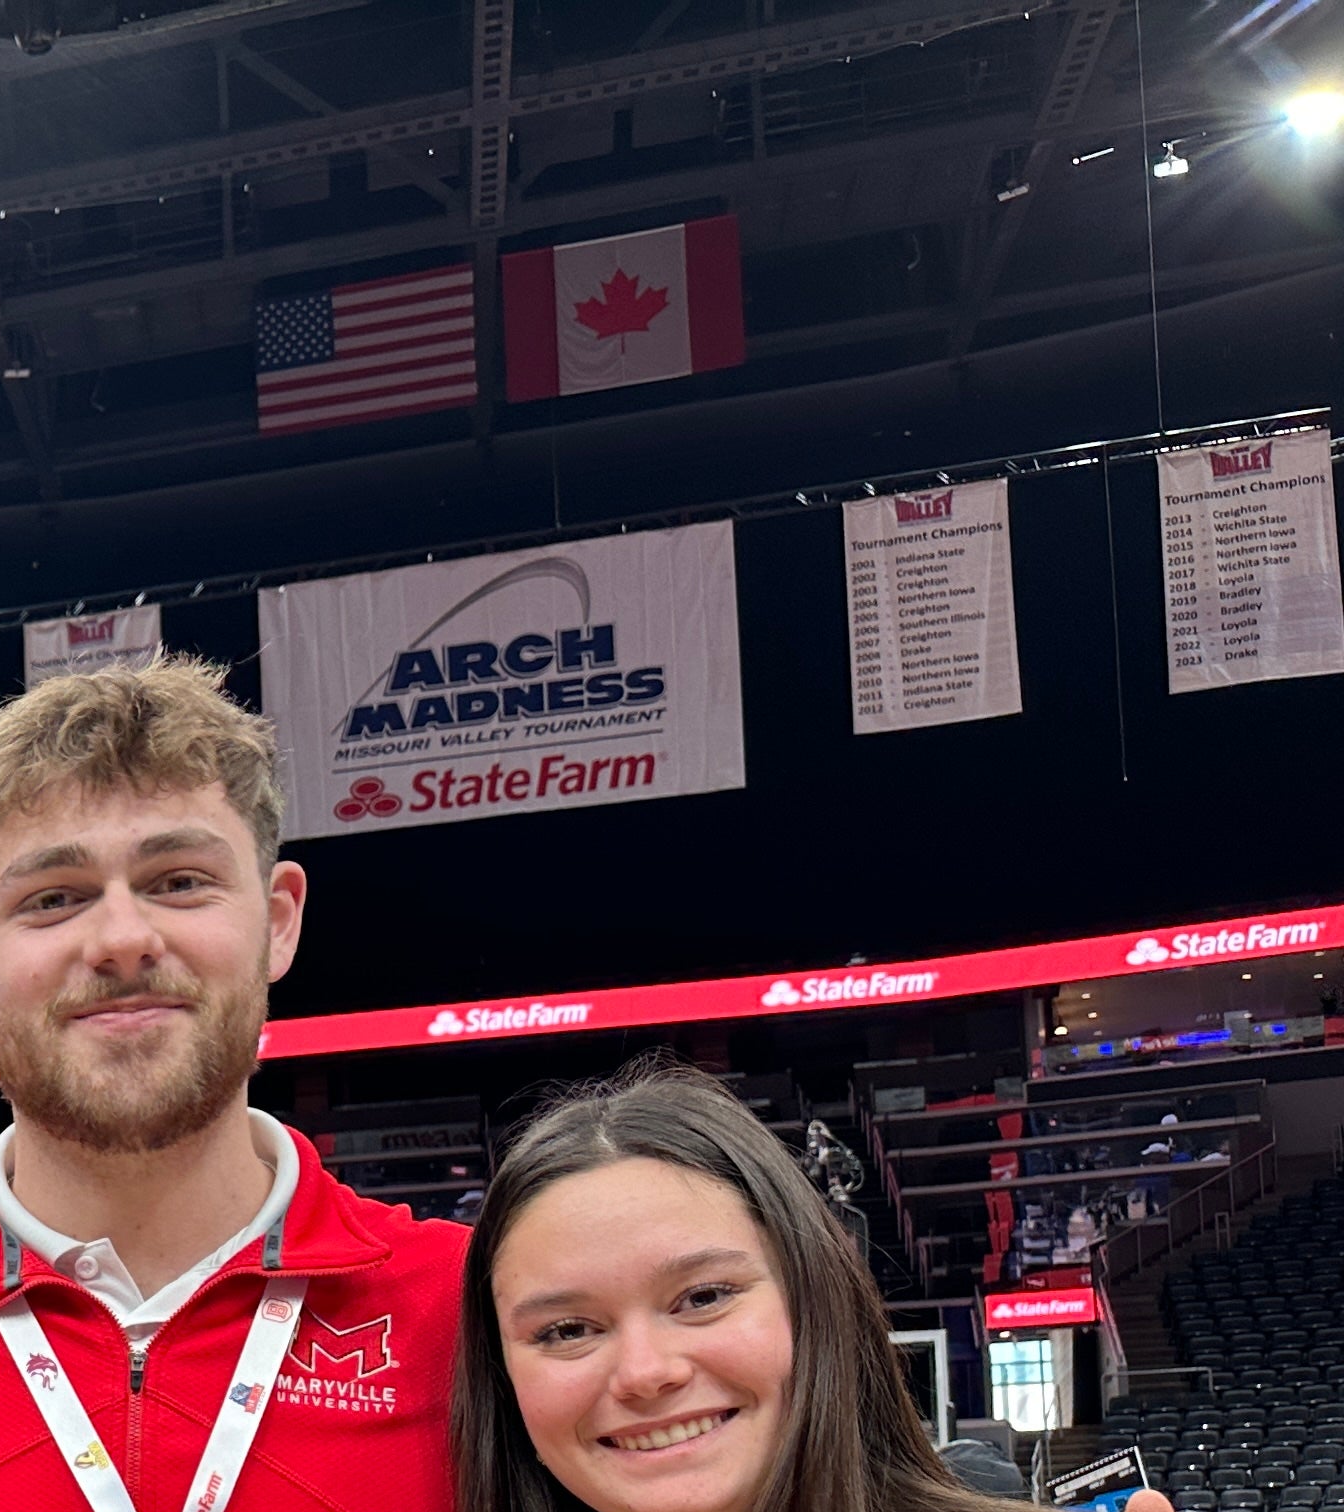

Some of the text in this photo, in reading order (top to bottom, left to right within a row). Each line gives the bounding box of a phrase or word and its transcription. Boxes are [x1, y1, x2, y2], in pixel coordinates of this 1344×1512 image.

[1165, 485, 1247, 506] Tournament
[1250, 474, 1326, 492] Champions
[1165, 503, 1267, 526] 2013 Creighton
[851, 532, 928, 551] Tournament
[931, 521, 1003, 541] Champions
[1166, 514, 1288, 540] 2014 Wichita State
[1166, 526, 1296, 554] 2015 Northern Iowa
[895, 551, 935, 565] Indiana
[938, 547, 966, 559] State
[1168, 540, 1297, 567] 2016 Northern Iowa
[896, 563, 948, 579] Creighton
[1169, 555, 1291, 580] 2017 Wichita State
[897, 576, 949, 592] Creighton
[1169, 573, 1255, 593] 2018 Loyola
[897, 589, 947, 604] Northern
[949, 586, 976, 597] Iowa
[1170, 586, 1262, 607] 2019 Bradley
[898, 602, 950, 619] Creighton
[899, 615, 948, 631] Southern
[950, 610, 986, 623] Illinois
[1171, 601, 1263, 622] 2020 Bradley
[900, 629, 952, 645] Creighton
[1172, 617, 1258, 637] 2021 Loyola
[900, 645, 932, 658] Drake
[1174, 632, 1261, 651] 2022 Loyola
[384, 623, 616, 696] ARCH
[901, 656, 950, 671] Northern
[953, 652, 980, 663] Iowa
[1175, 649, 1258, 668] 2023 Drake
[902, 669, 951, 684] Northern
[954, 665, 980, 677] Iowa
[903, 683, 943, 697] Indiana
[945, 678, 974, 691] State
[341, 666, 666, 742] MADNESS
[903, 695, 956, 711] Creighton
[334, 707, 666, 762] MISSOURI VALLEY TOURNAMENT
[276, 1375, 397, 1403] MARYVILLE
[276, 1391, 396, 1414] UNIVERSITY
